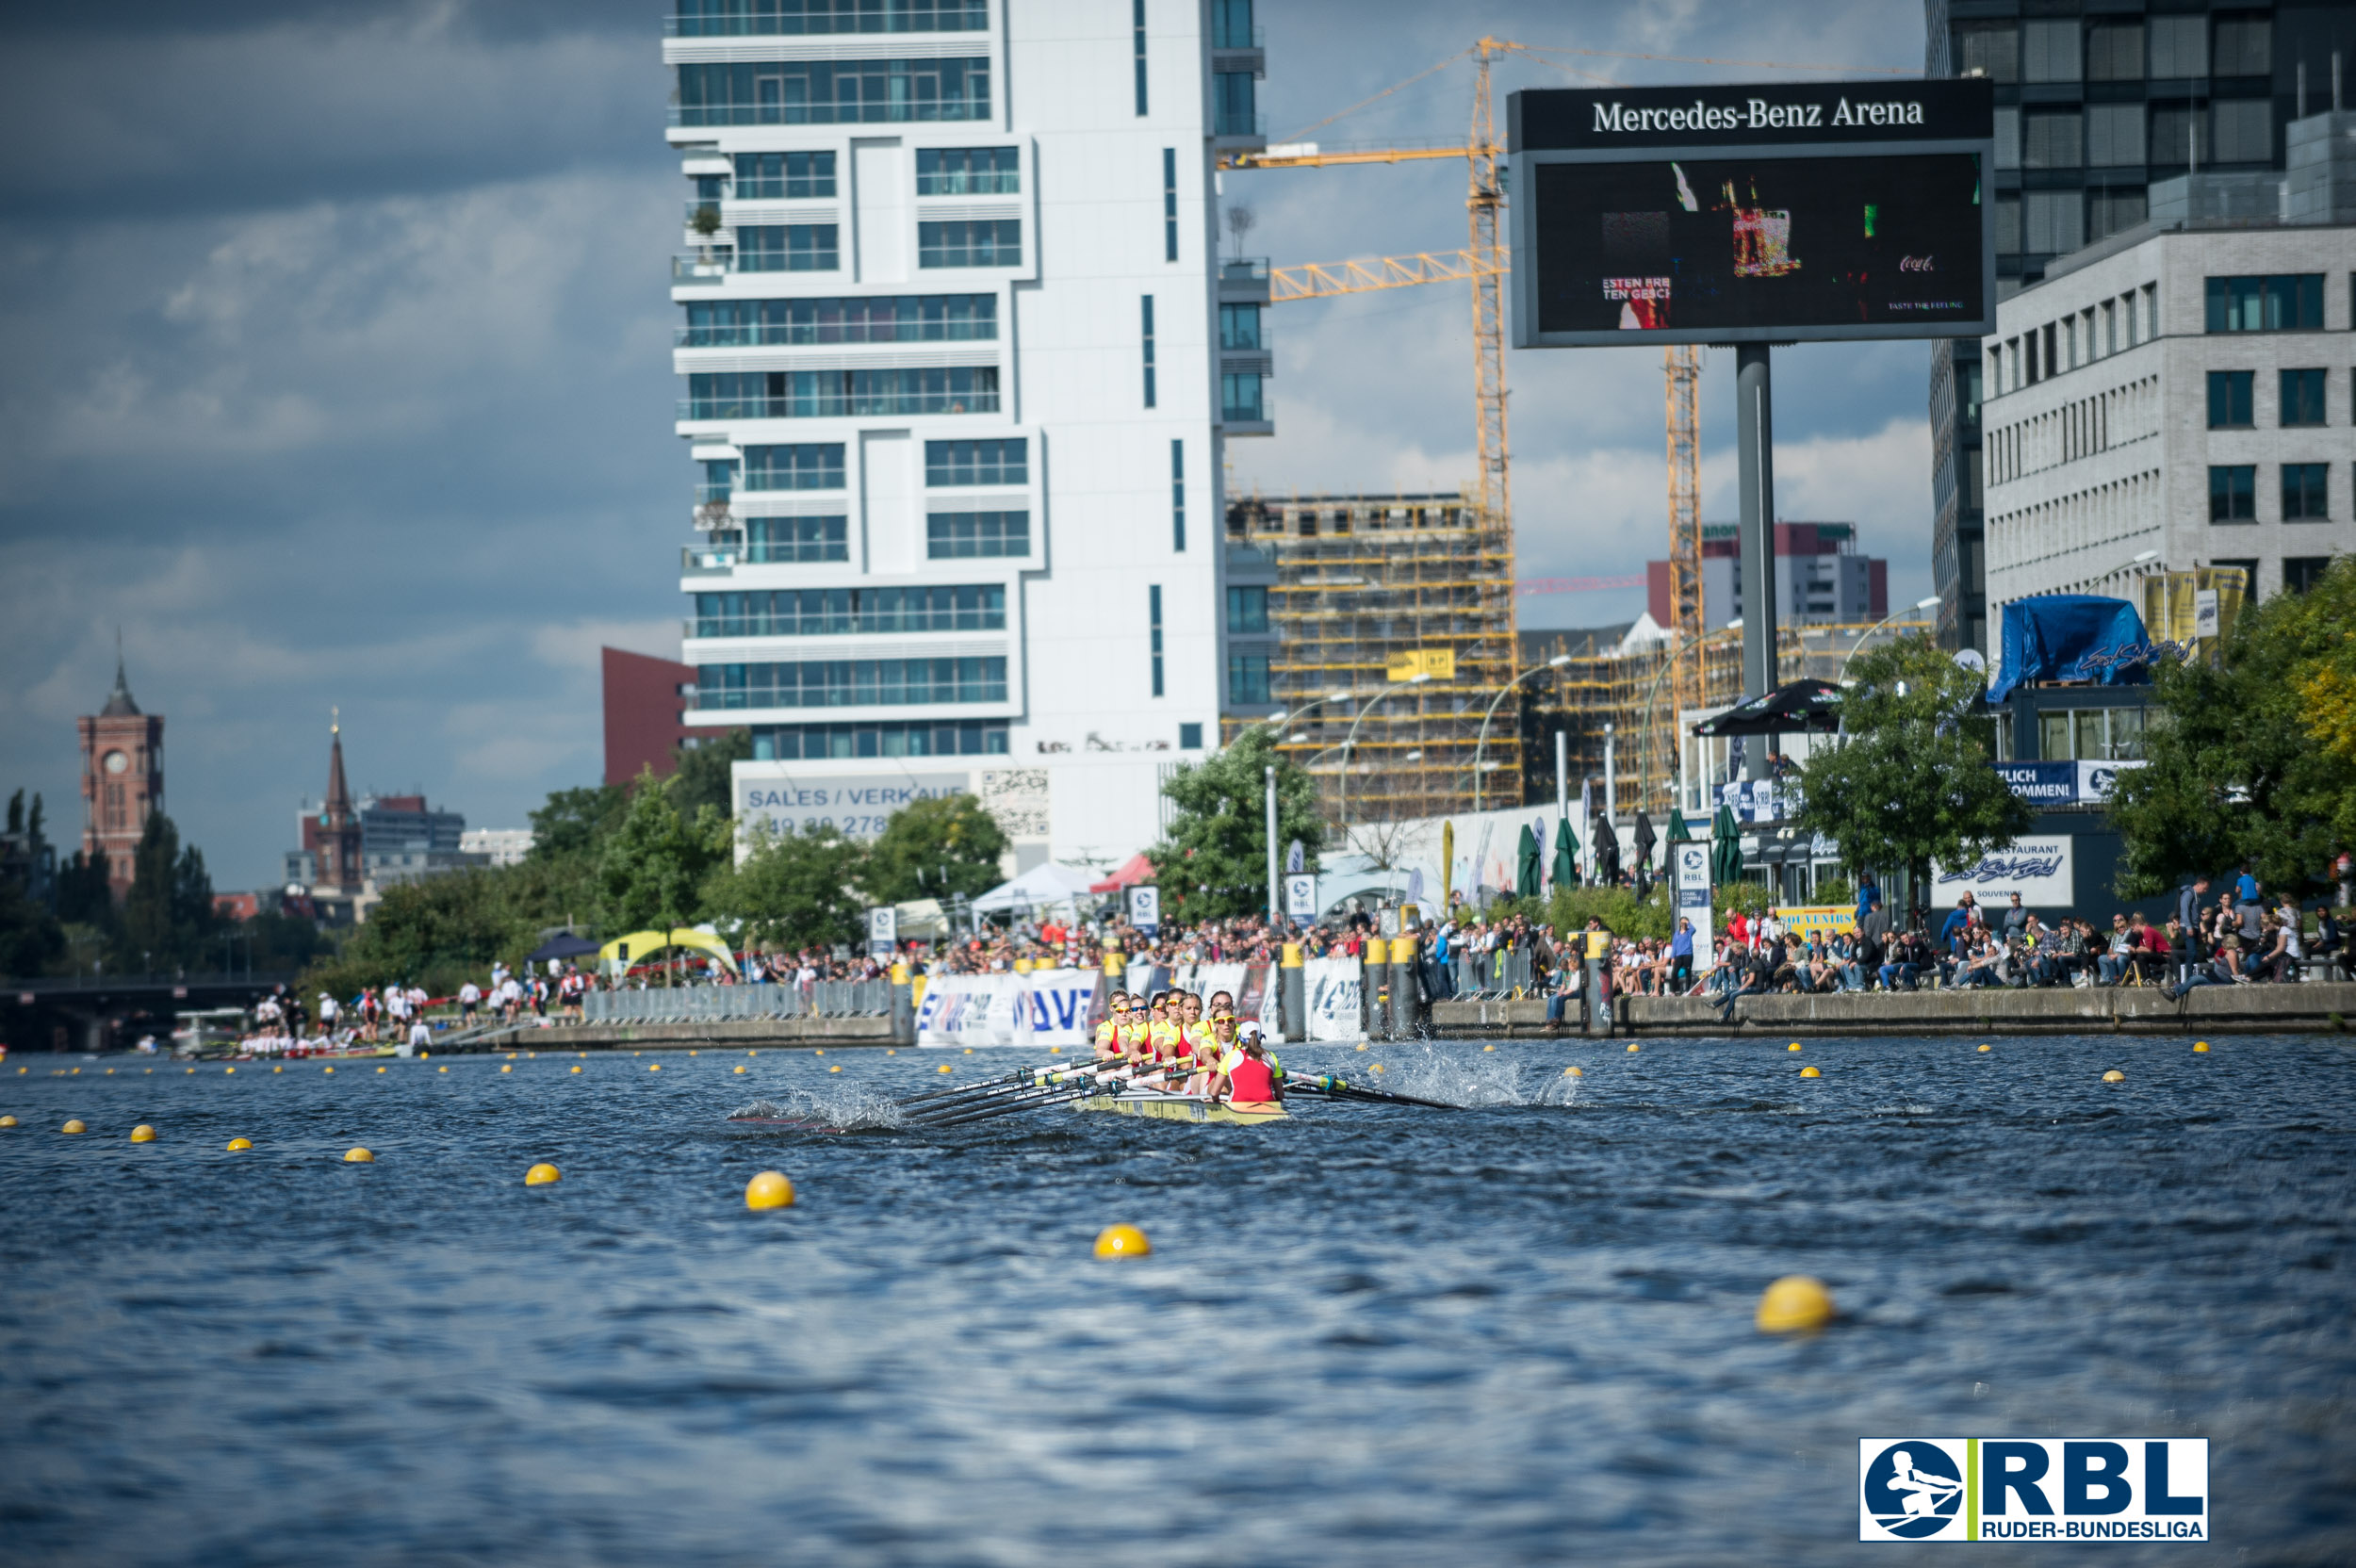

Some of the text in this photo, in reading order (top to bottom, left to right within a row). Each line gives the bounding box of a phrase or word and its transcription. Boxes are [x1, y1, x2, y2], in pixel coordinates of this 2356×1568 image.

[1593, 97, 1924, 132] Mercedes-Benz Arena
[1603, 289, 1628, 301] TEN
[749, 789, 828, 808] SALES
[835, 790, 843, 806] /
[1684, 874, 1704, 882] RBL
[1780, 913, 1852, 924] SOUVENIRS
